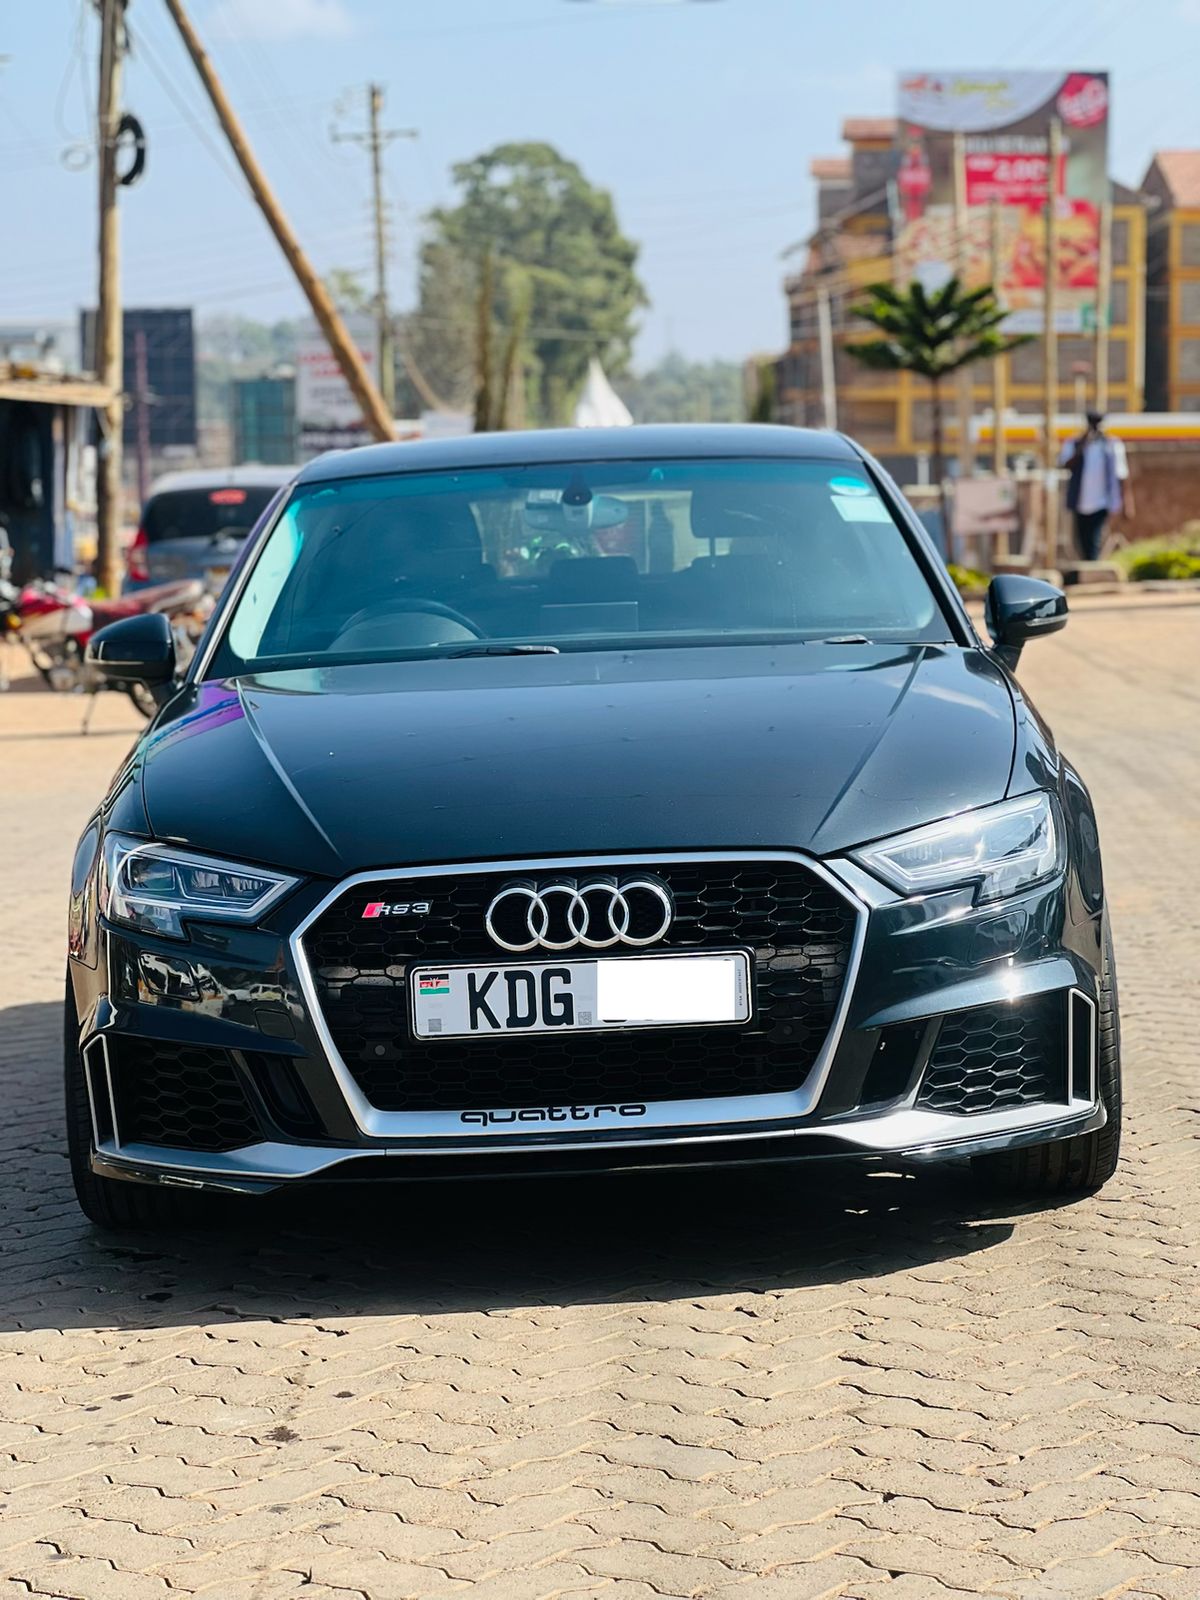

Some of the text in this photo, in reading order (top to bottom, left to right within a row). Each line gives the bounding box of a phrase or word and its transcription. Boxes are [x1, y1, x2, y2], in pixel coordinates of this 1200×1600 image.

[370, 901, 431, 917] RS3
[466, 967, 575, 1031] KDG
[460, 1103, 647, 1127] quattro
